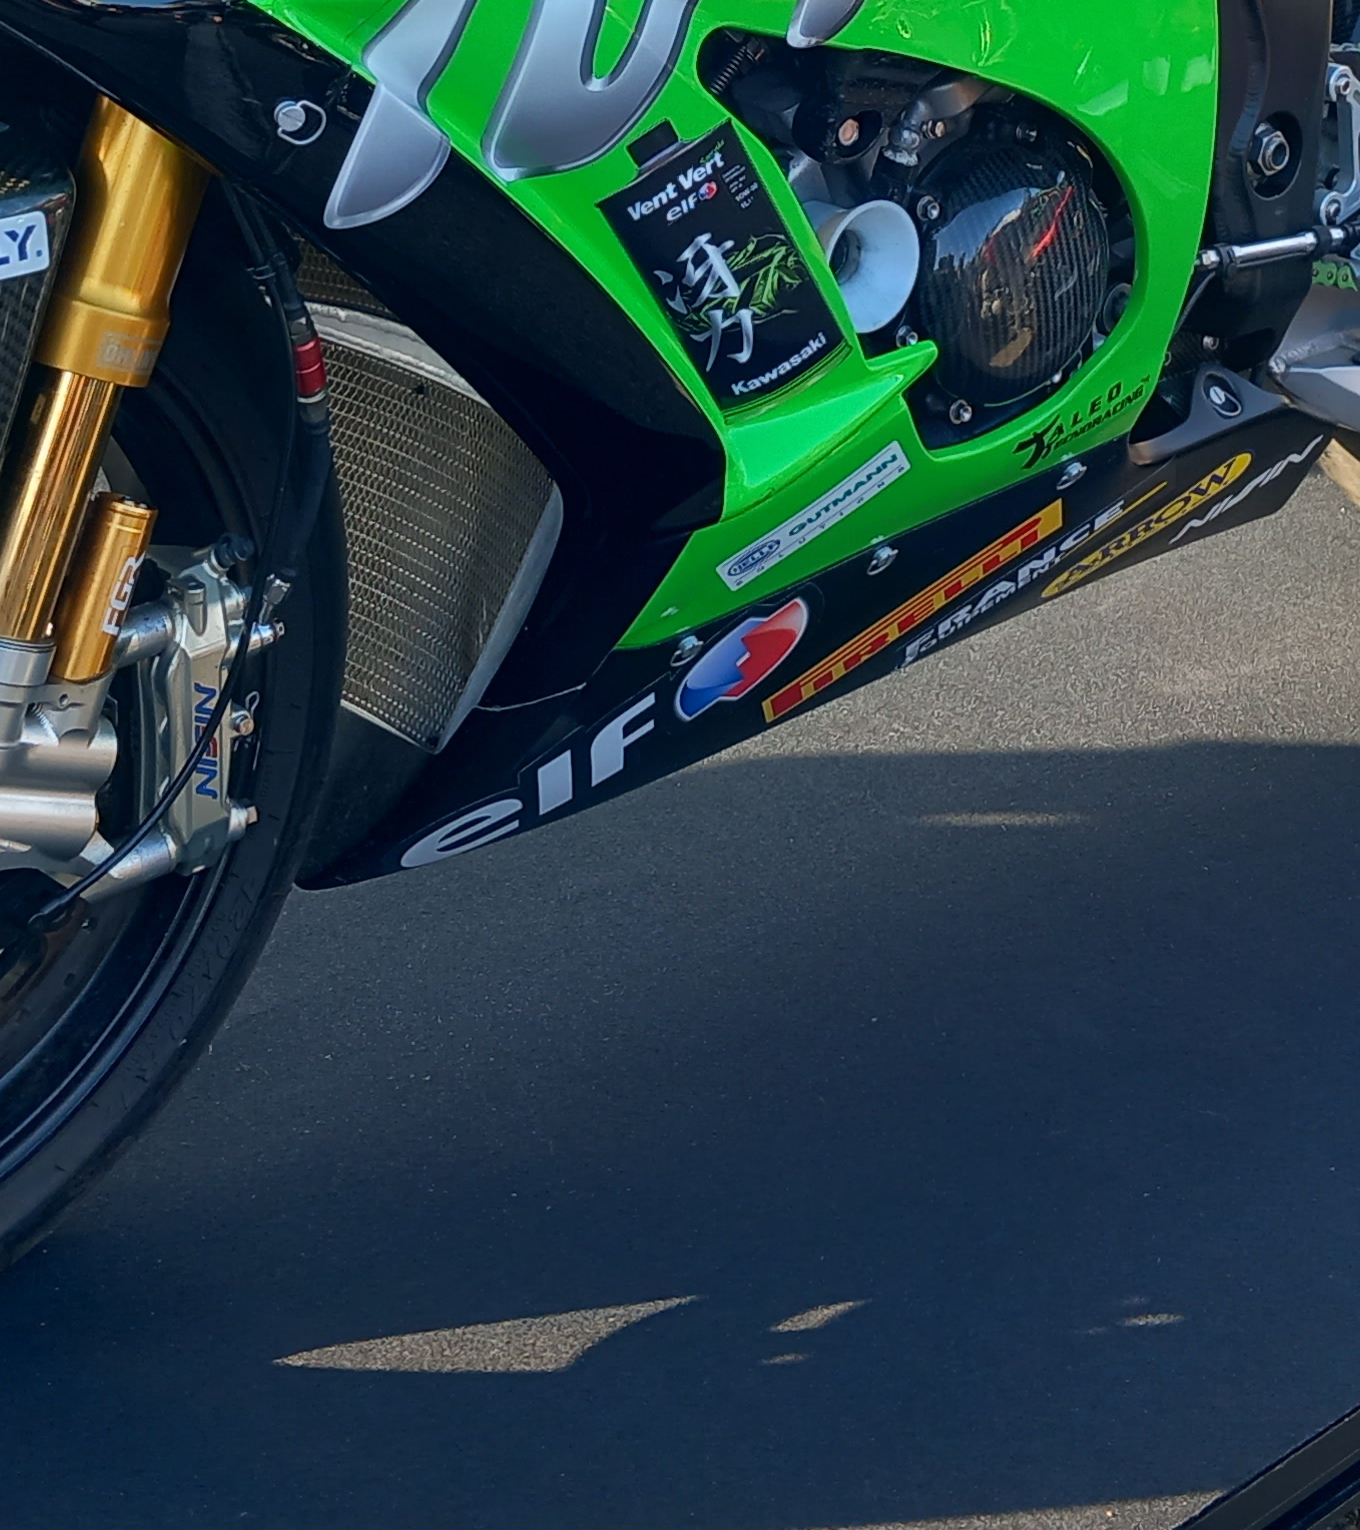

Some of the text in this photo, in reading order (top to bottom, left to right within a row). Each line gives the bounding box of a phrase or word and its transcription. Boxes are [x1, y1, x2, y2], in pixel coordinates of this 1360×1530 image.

[627, 182, 679, 221] Vent
[677, 151, 726, 191] Vert
[666, 193, 698, 223] elf
[730, 331, 828, 396] Kawasaki
[789, 453, 899, 537] GUTMANN
[1062, 459, 1240, 583] ARROW
[101, 550, 146, 637] FGR
[769, 516, 1043, 719] PIRELLI
[904, 499, 1125, 665] FRANCE
[400, 691, 656, 868] elf
